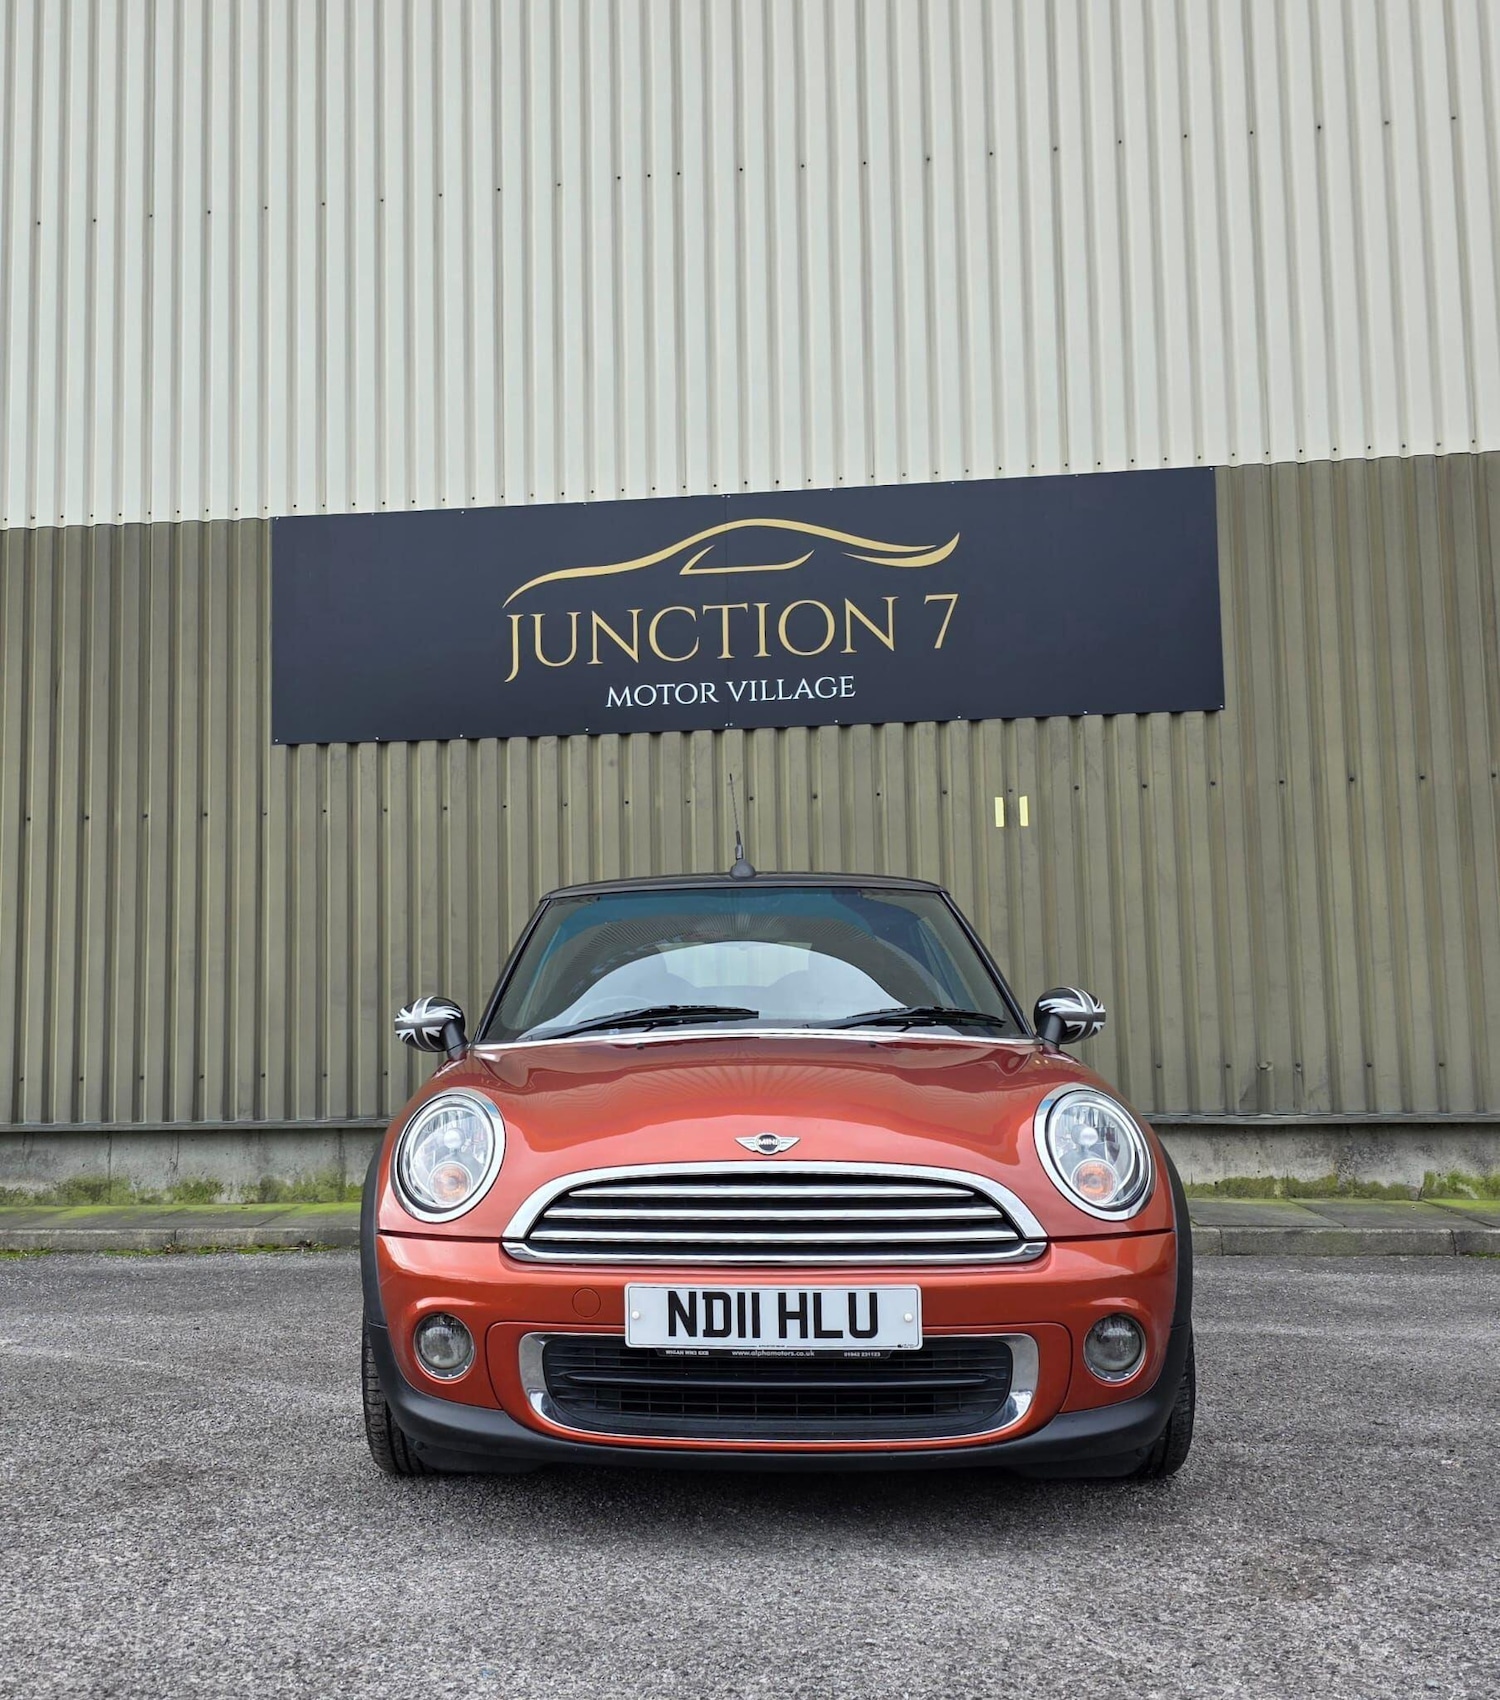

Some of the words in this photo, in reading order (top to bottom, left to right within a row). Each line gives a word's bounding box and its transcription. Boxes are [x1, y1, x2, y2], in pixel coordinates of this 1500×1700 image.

[504, 596, 899, 683] JUNCTION
[923, 593, 959, 650] 7
[605, 682, 719, 708] MOTOR
[725, 675, 856, 703] VILLAGE
[758, 1138, 778, 1146] MINI
[668, 1291, 760, 1338] ND11
[778, 1292, 878, 1339] HLU
